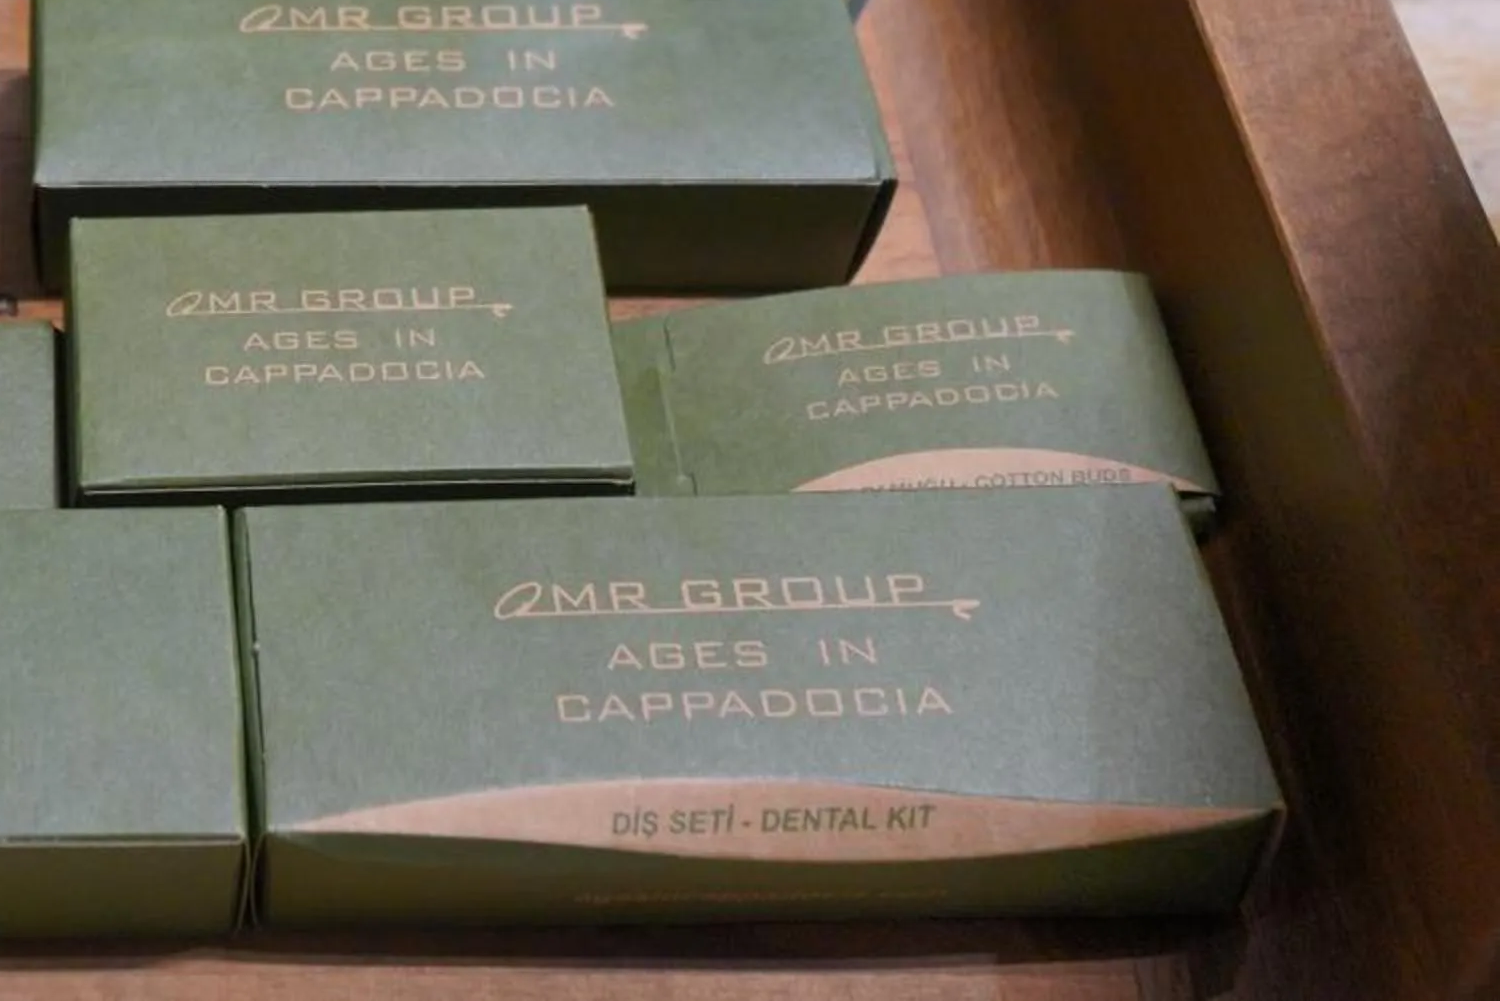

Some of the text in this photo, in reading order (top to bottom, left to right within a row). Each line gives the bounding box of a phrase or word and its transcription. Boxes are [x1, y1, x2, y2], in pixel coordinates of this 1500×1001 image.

[398, 4, 602, 32] GROUP
[330, 51, 556, 72] AGES IN
[284, 86, 615, 110] CAPPADOCIA
[301, 286, 475, 311] GROUP
[243, 328, 436, 351] AGES IN
[882, 315, 1040, 349] GROUP
[205, 360, 485, 385] CAPPADOCIA
[838, 353, 1011, 385] AGES IN
[806, 381, 1059, 420] CAPPADOCIA
[682, 574, 925, 610] GROUP
[607, 637, 878, 668] AGES IN
[557, 686, 953, 723] CAPPADOCIA
[611, 809, 659, 839] DİŞ
[669, 803, 734, 834] SETİ
[760, 807, 877, 834] DENTAL
[887, 805, 936, 829] KIT
